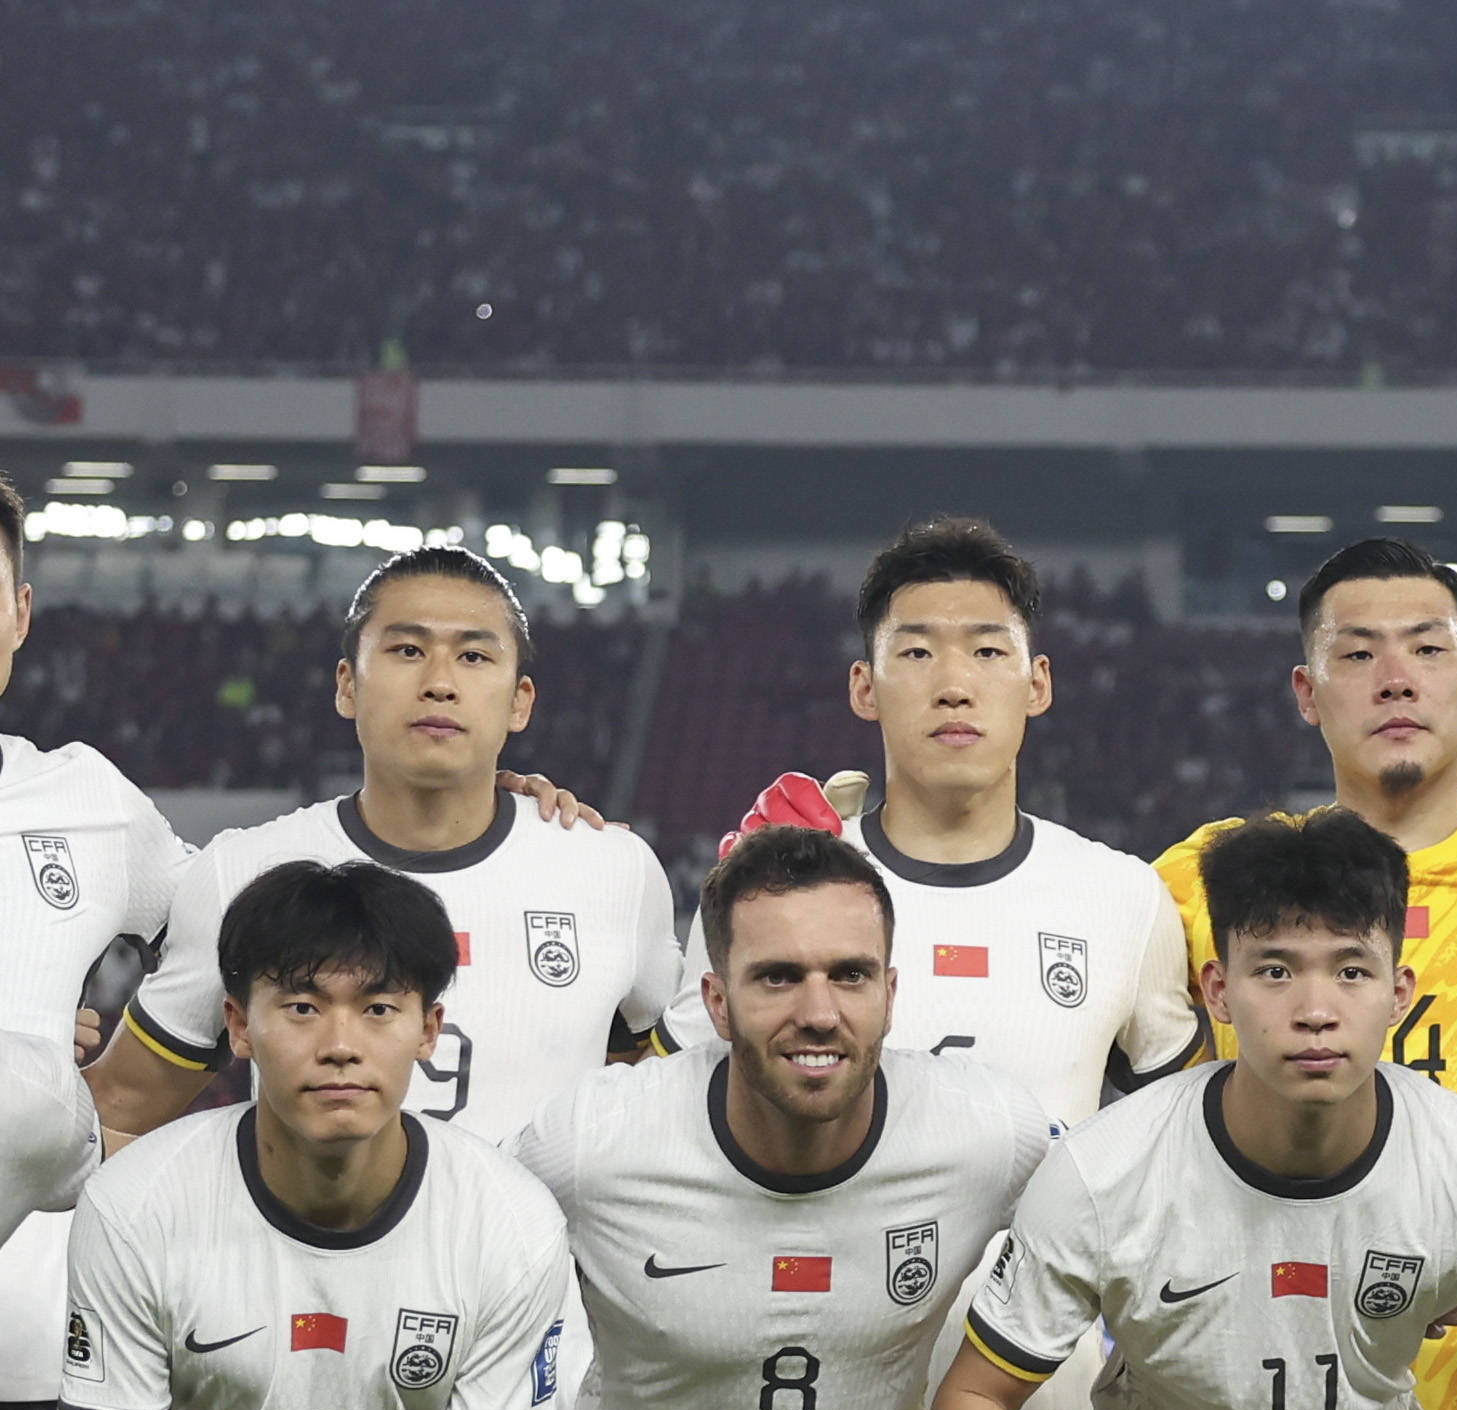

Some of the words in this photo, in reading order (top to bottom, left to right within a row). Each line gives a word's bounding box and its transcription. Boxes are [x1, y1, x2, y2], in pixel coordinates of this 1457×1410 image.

[529, 916, 572, 931] CFA
[1043, 937, 1084, 955] CFA
[891, 1227, 935, 1250] CFA
[1367, 1257, 1418, 1275] CFA
[402, 1315, 452, 1335] CFA
[415, 1332, 435, 1344] 中国
